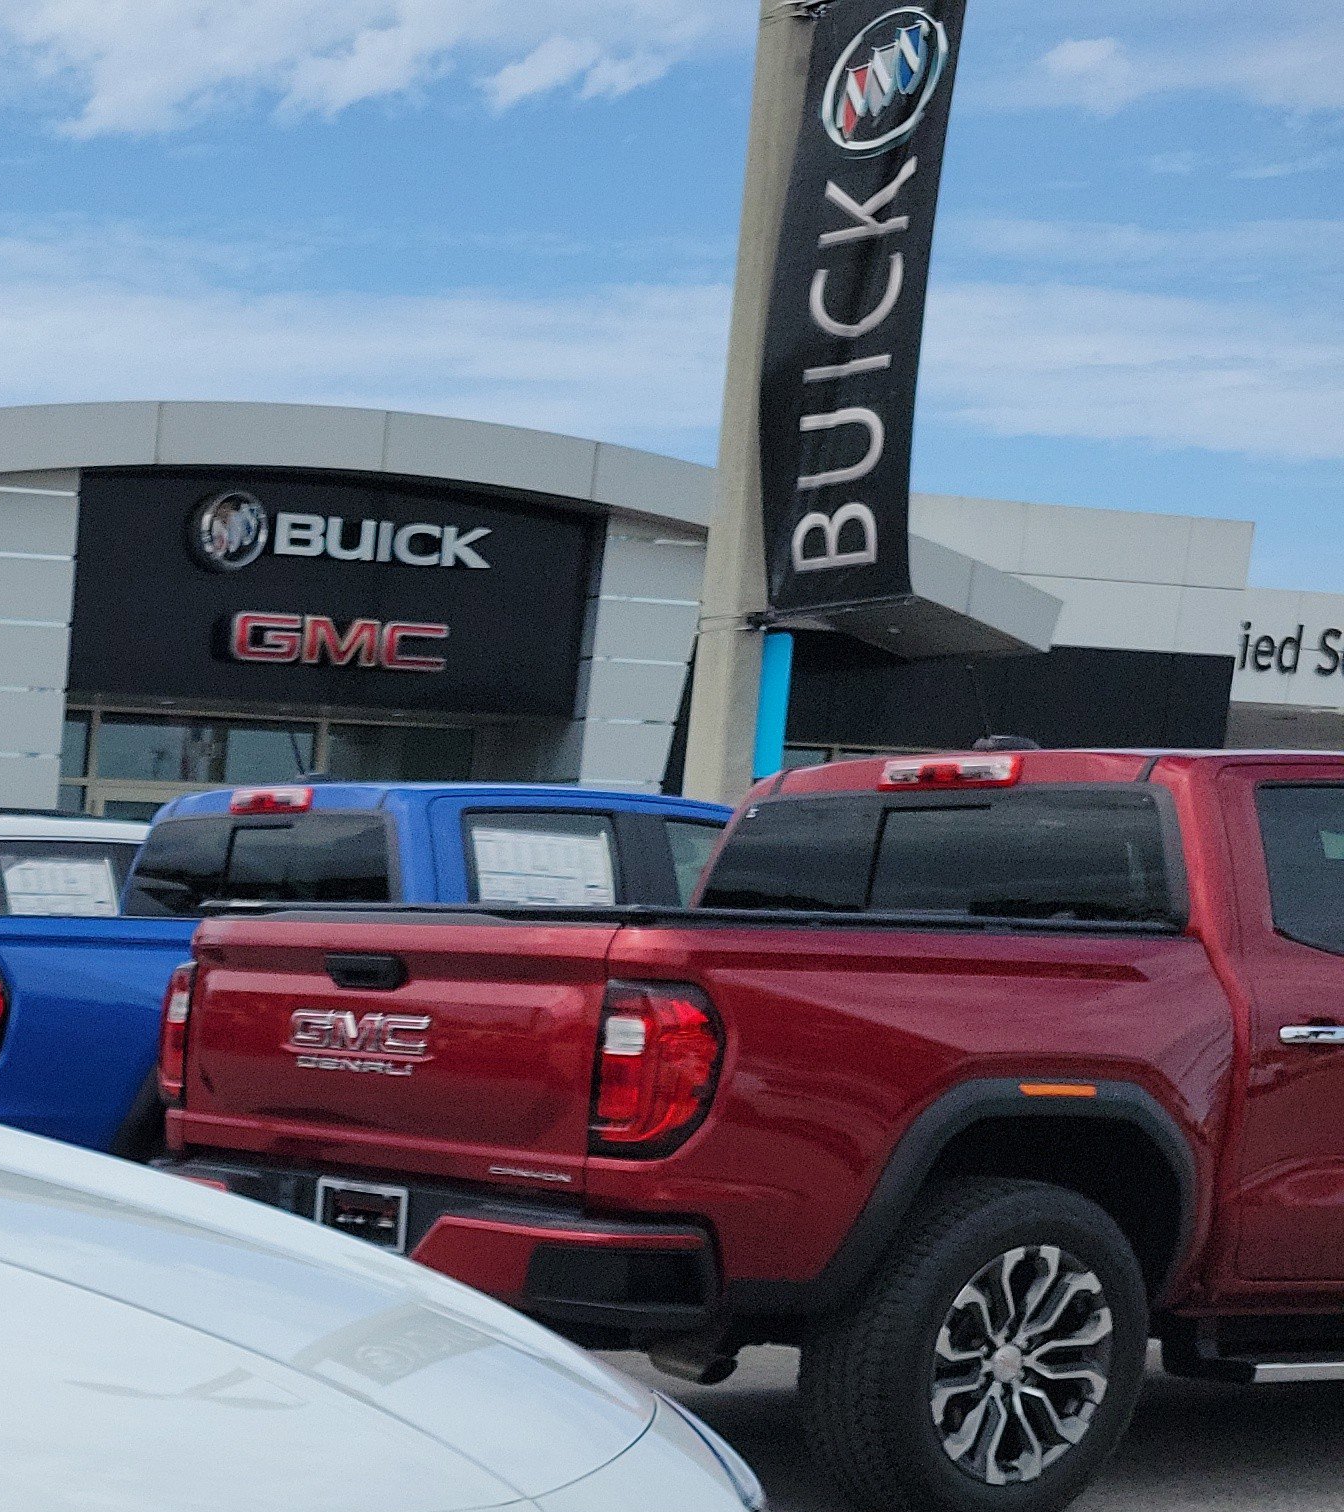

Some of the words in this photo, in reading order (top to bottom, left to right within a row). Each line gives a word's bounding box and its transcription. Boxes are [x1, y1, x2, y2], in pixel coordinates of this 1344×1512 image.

[791, 155, 918, 574] BUICK
[273, 511, 493, 569] BUICK
[231, 610, 450, 672] GMC
[1315, 628, 1344, 677] S
[290, 1008, 432, 1055] GMC
